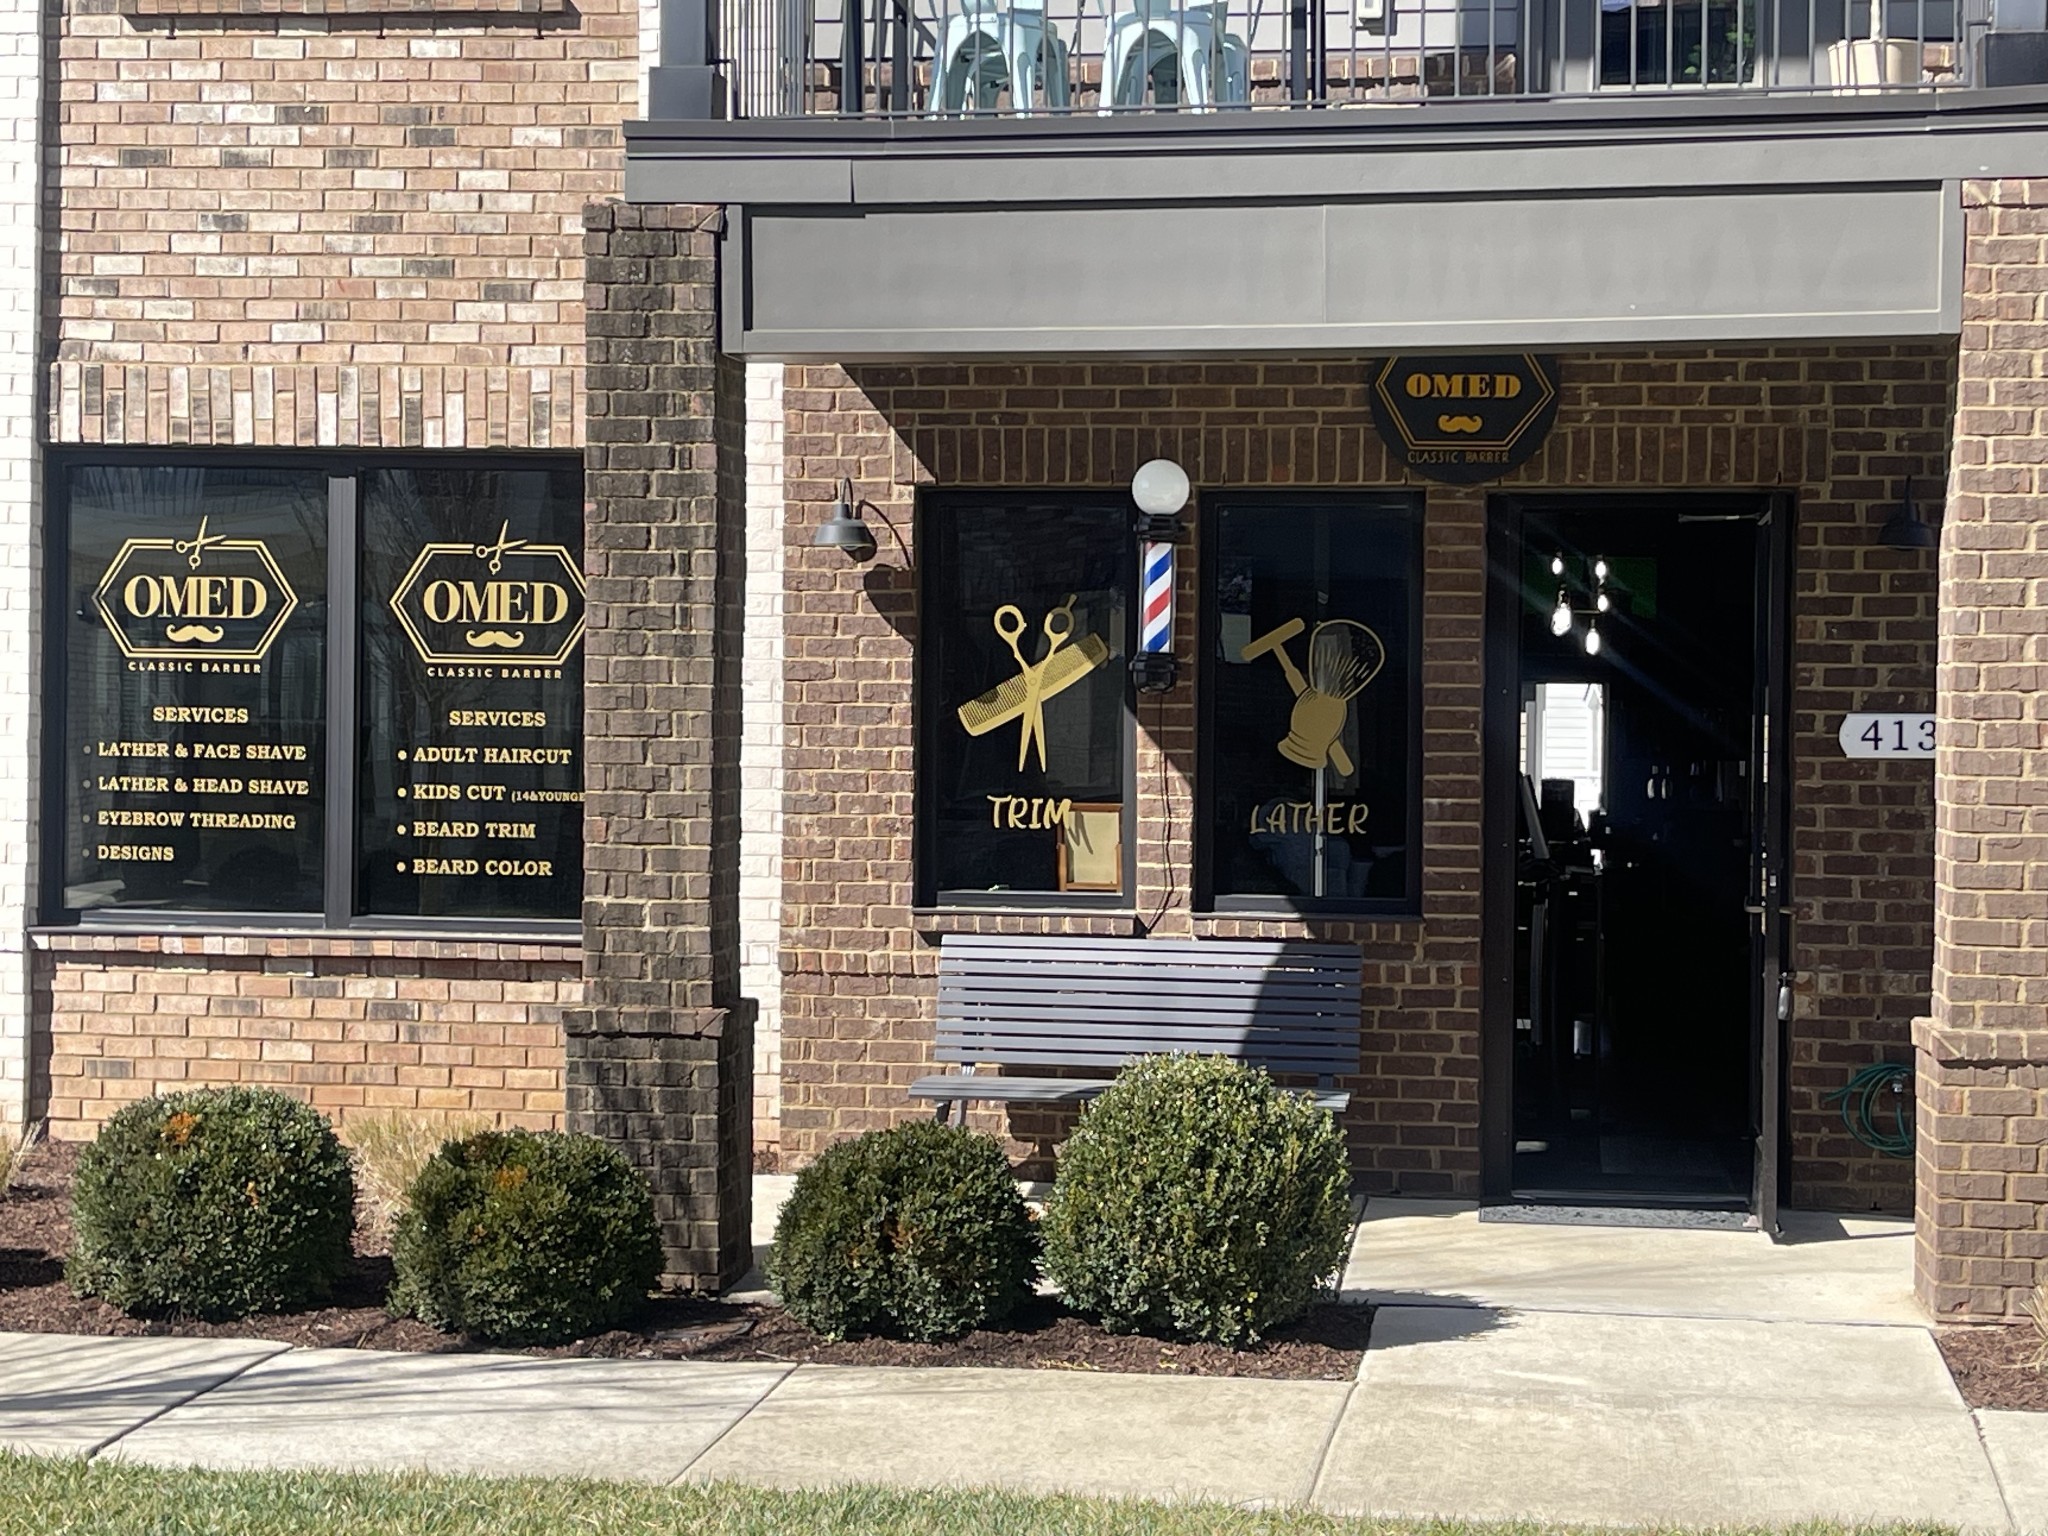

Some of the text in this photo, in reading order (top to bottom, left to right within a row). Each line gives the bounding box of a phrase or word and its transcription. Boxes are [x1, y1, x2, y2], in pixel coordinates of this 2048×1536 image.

[1406, 373, 1521, 398] OMED
[1408, 451, 1510, 464] CLASSIC BARBER
[124, 574, 267, 619] OMED
[423, 580, 569, 624] OMED
[127, 661, 262, 674] CLASSIC BARBER
[427, 667, 562, 679] CLASSIC BARBER
[153, 706, 249, 724] SERVICES
[449, 710, 547, 727] SERVICES
[1861, 719, 1936, 751] 413
[98, 742, 307, 760] LATHER & FACE SHAVE
[413, 747, 572, 764] ADULT HAIRCUT
[98, 777, 310, 795] LATHER & HEAD SHAVE
[413, 784, 461, 800] KIDS
[466, 785, 506, 800] CUT
[97, 811, 296, 829] EYEBROW THREADING
[986, 794, 1073, 830] TRIM
[1250, 801, 1369, 834] LATHER
[413, 821, 536, 838] BEARD TRIM
[97, 845, 175, 861] DESIGNS
[412, 859, 553, 876] BEARD COLOR
